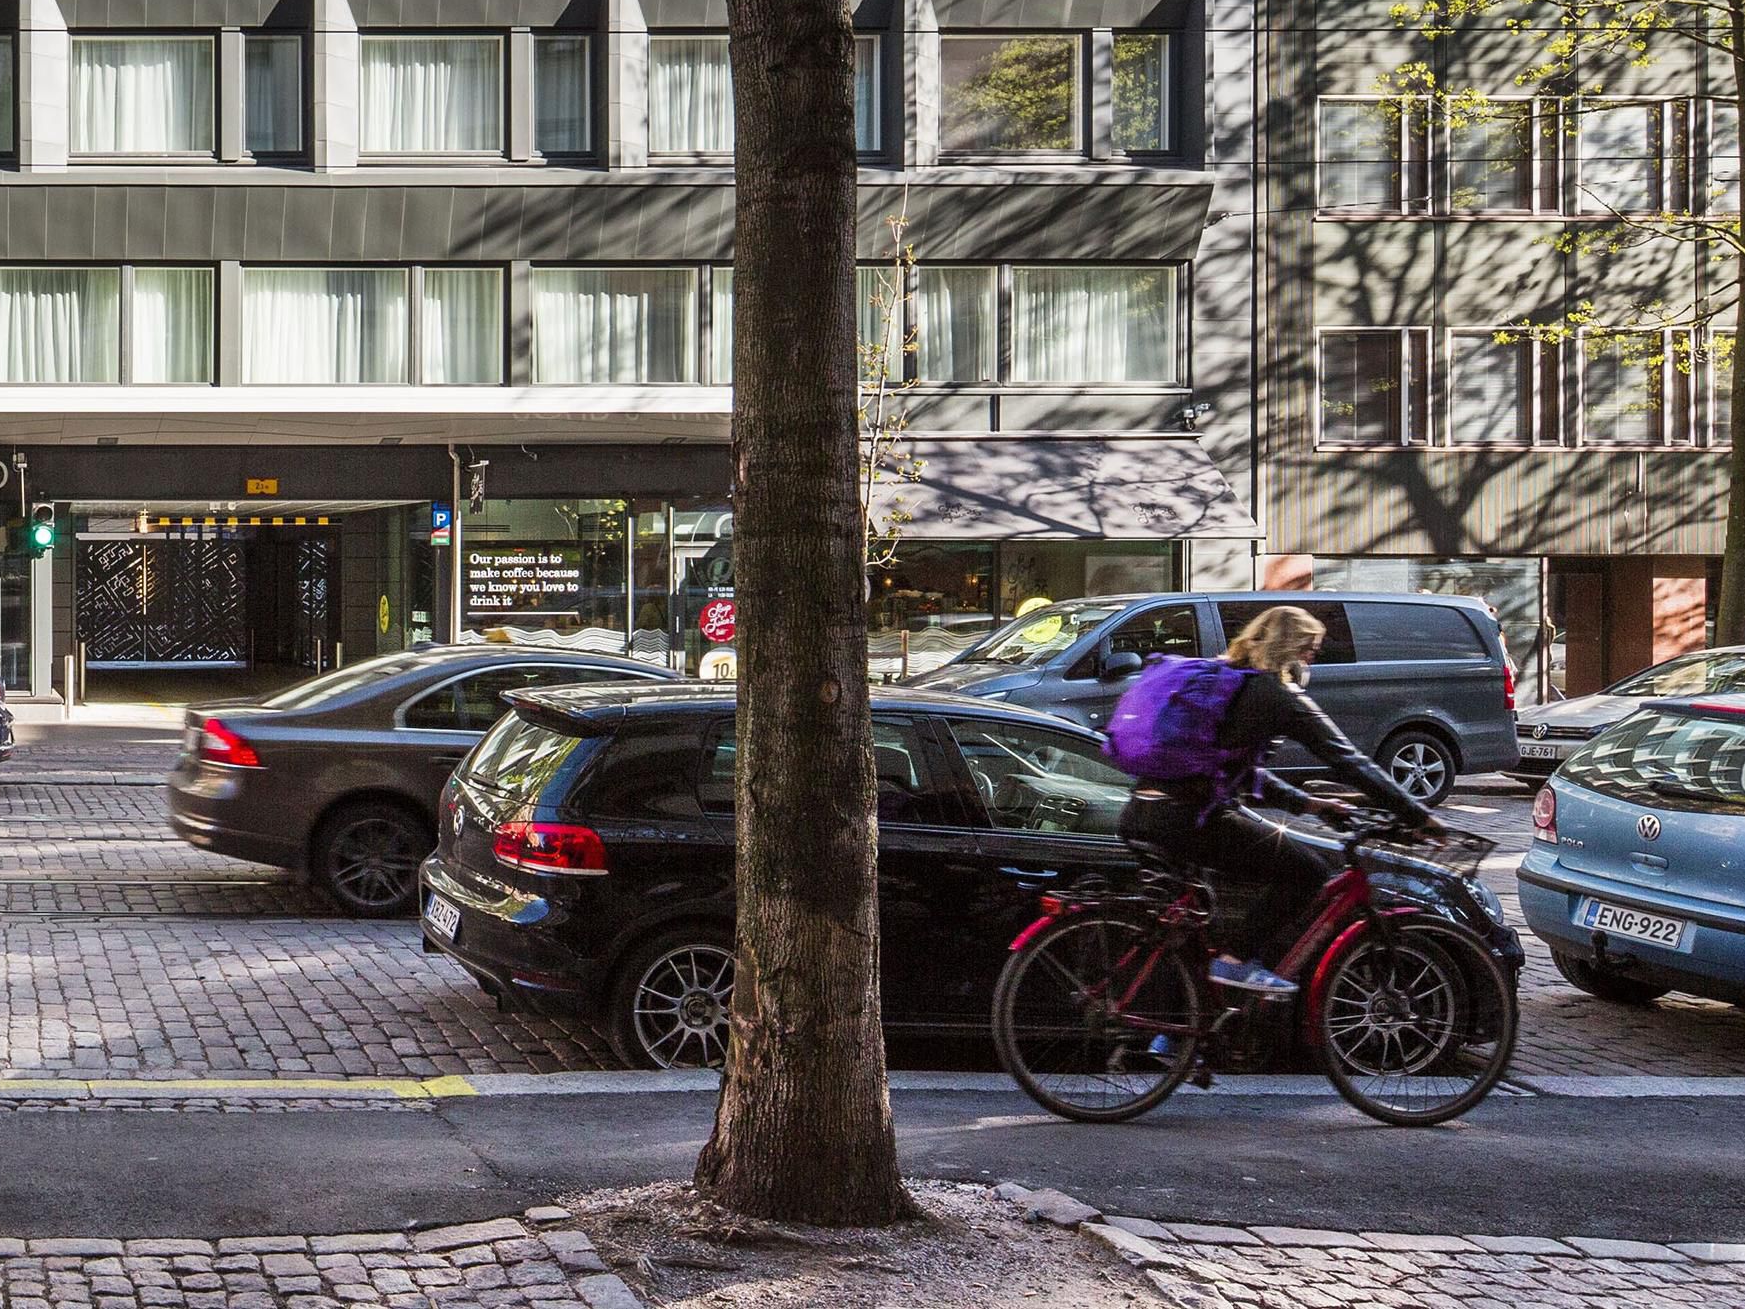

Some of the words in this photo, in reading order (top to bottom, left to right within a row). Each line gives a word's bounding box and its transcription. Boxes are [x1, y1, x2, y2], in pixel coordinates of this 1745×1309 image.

[436, 513, 447, 526] P
[469, 553, 492, 564] Our
[494, 553, 535, 566] passion
[537, 553, 548, 564] is
[550, 554, 562, 564] to
[469, 567, 501, 578] make
[502, 567, 534, 578] coffee
[536, 567, 579, 578] because
[469, 583, 486, 592] we
[488, 581, 518, 592] know
[520, 582, 540, 594] you
[542, 581, 565, 592] love
[567, 582, 579, 592] to
[469, 595, 501, 606] drink
[502, 595, 513, 606] it
[1560, 836, 1584, 849] POLO
[1597, 906, 1677, 943] ENG-922
